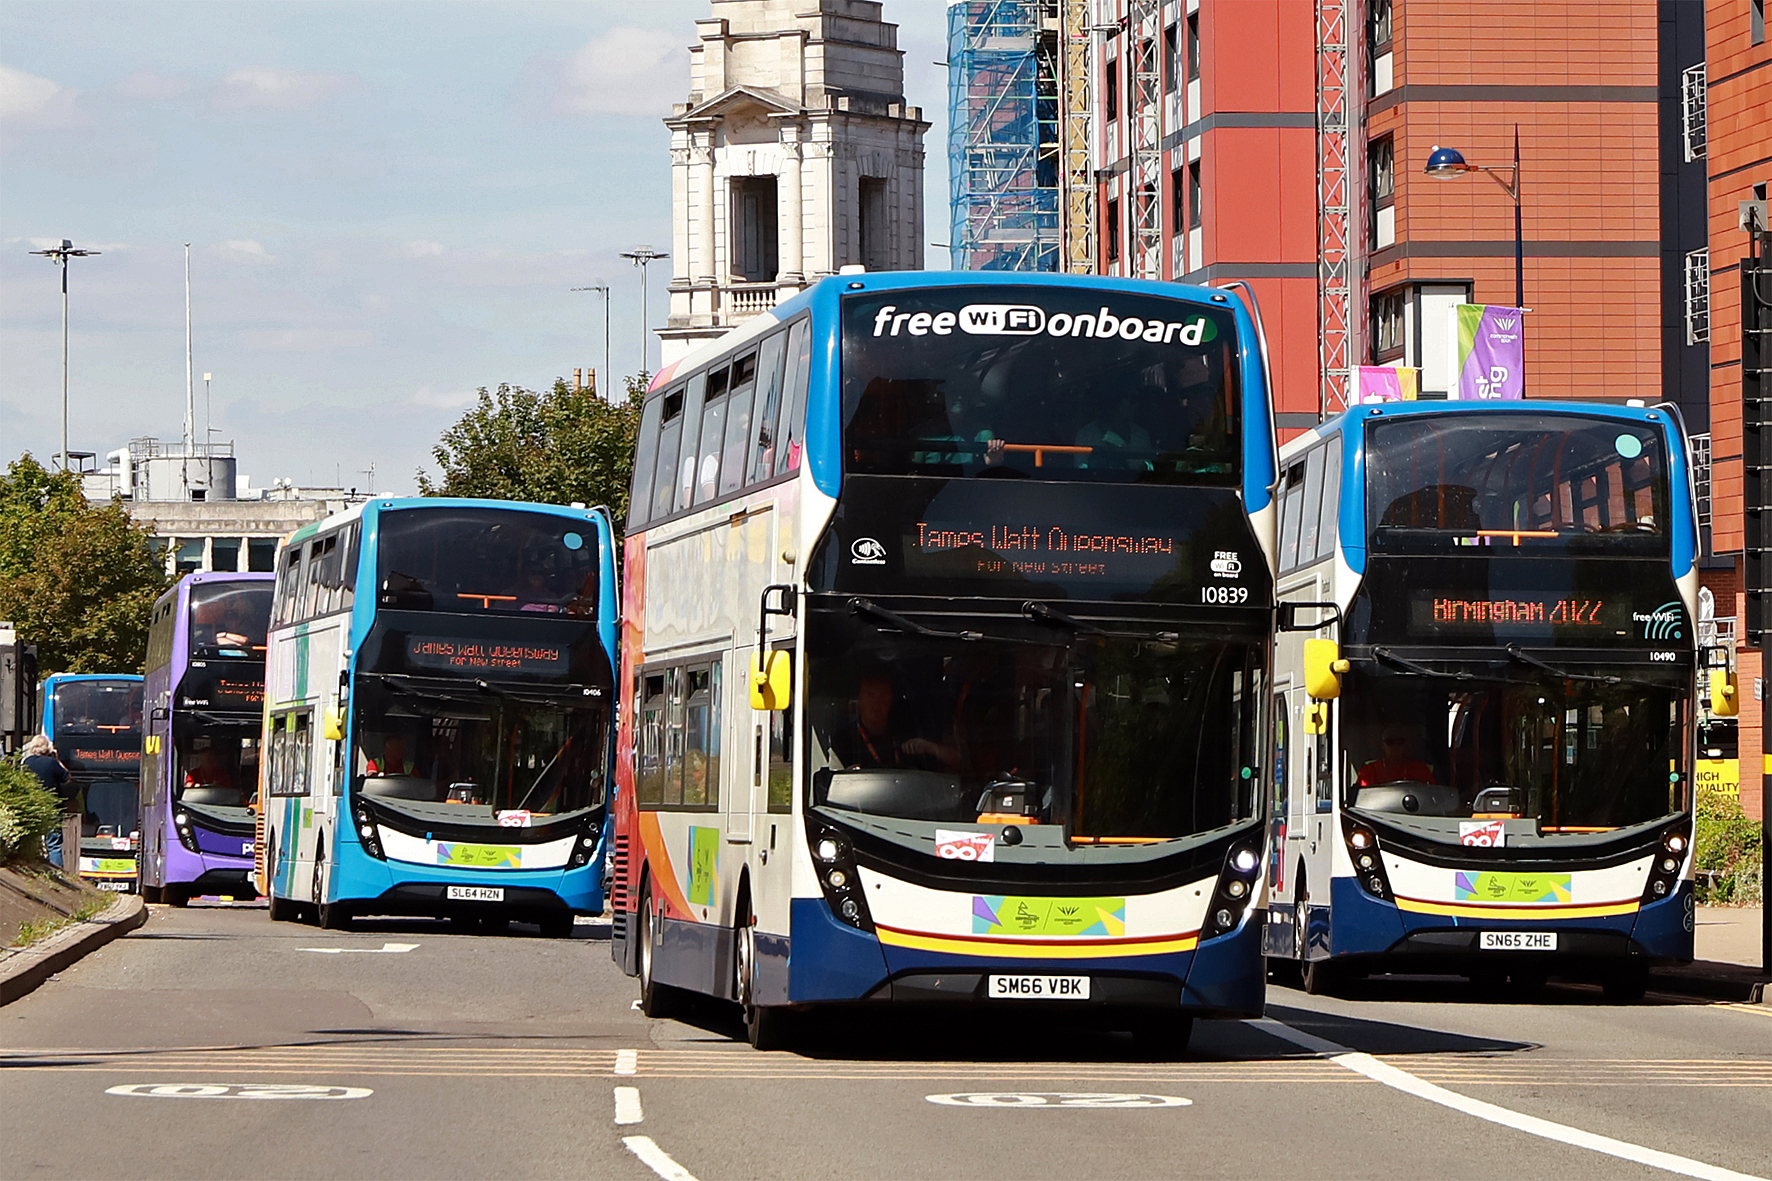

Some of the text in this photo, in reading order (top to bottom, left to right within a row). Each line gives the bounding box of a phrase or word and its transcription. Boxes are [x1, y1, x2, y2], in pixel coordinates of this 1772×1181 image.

[873, 305, 957, 337] free
[1046, 307, 1206, 346] onboard
[1213, 551, 1238, 561] FREE
[1202, 586, 1248, 604] 10839
[1433, 598, 1545, 622] Birmingham
[1632, 611, 1675, 622] free WiFi
[1650, 651, 1676, 662] 10490
[452, 888, 500, 899] SL64 HZN
[1486, 934, 1551, 947] SN65 ZHE
[997, 978, 1081, 994] SM66 VBK
